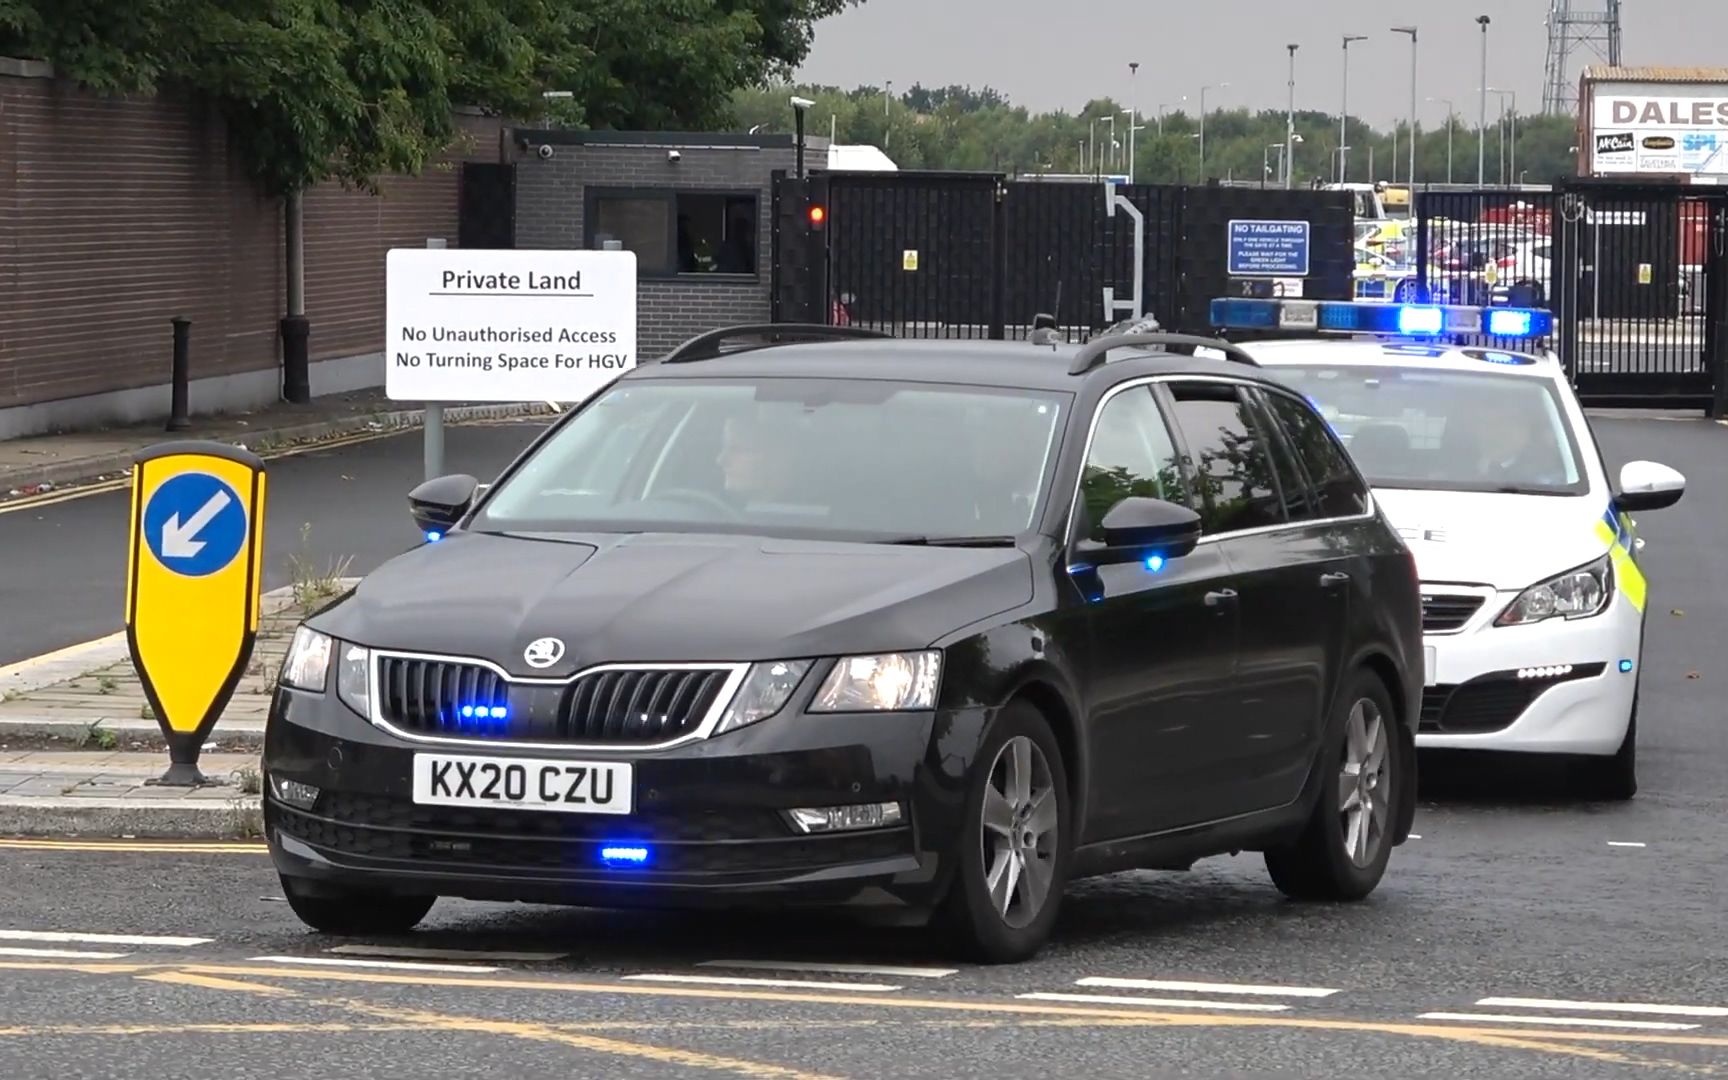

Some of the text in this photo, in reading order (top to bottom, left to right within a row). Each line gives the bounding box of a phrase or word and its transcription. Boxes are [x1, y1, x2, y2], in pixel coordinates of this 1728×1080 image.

[1235, 224, 1302, 233] NO TAILGATING
[442, 270, 581, 290] Private Land
[402, 326, 617, 344] No Unauthorised Access
[396, 352, 628, 372] No Turning Space For HGV
[430, 760, 614, 805] KX20 CZU
